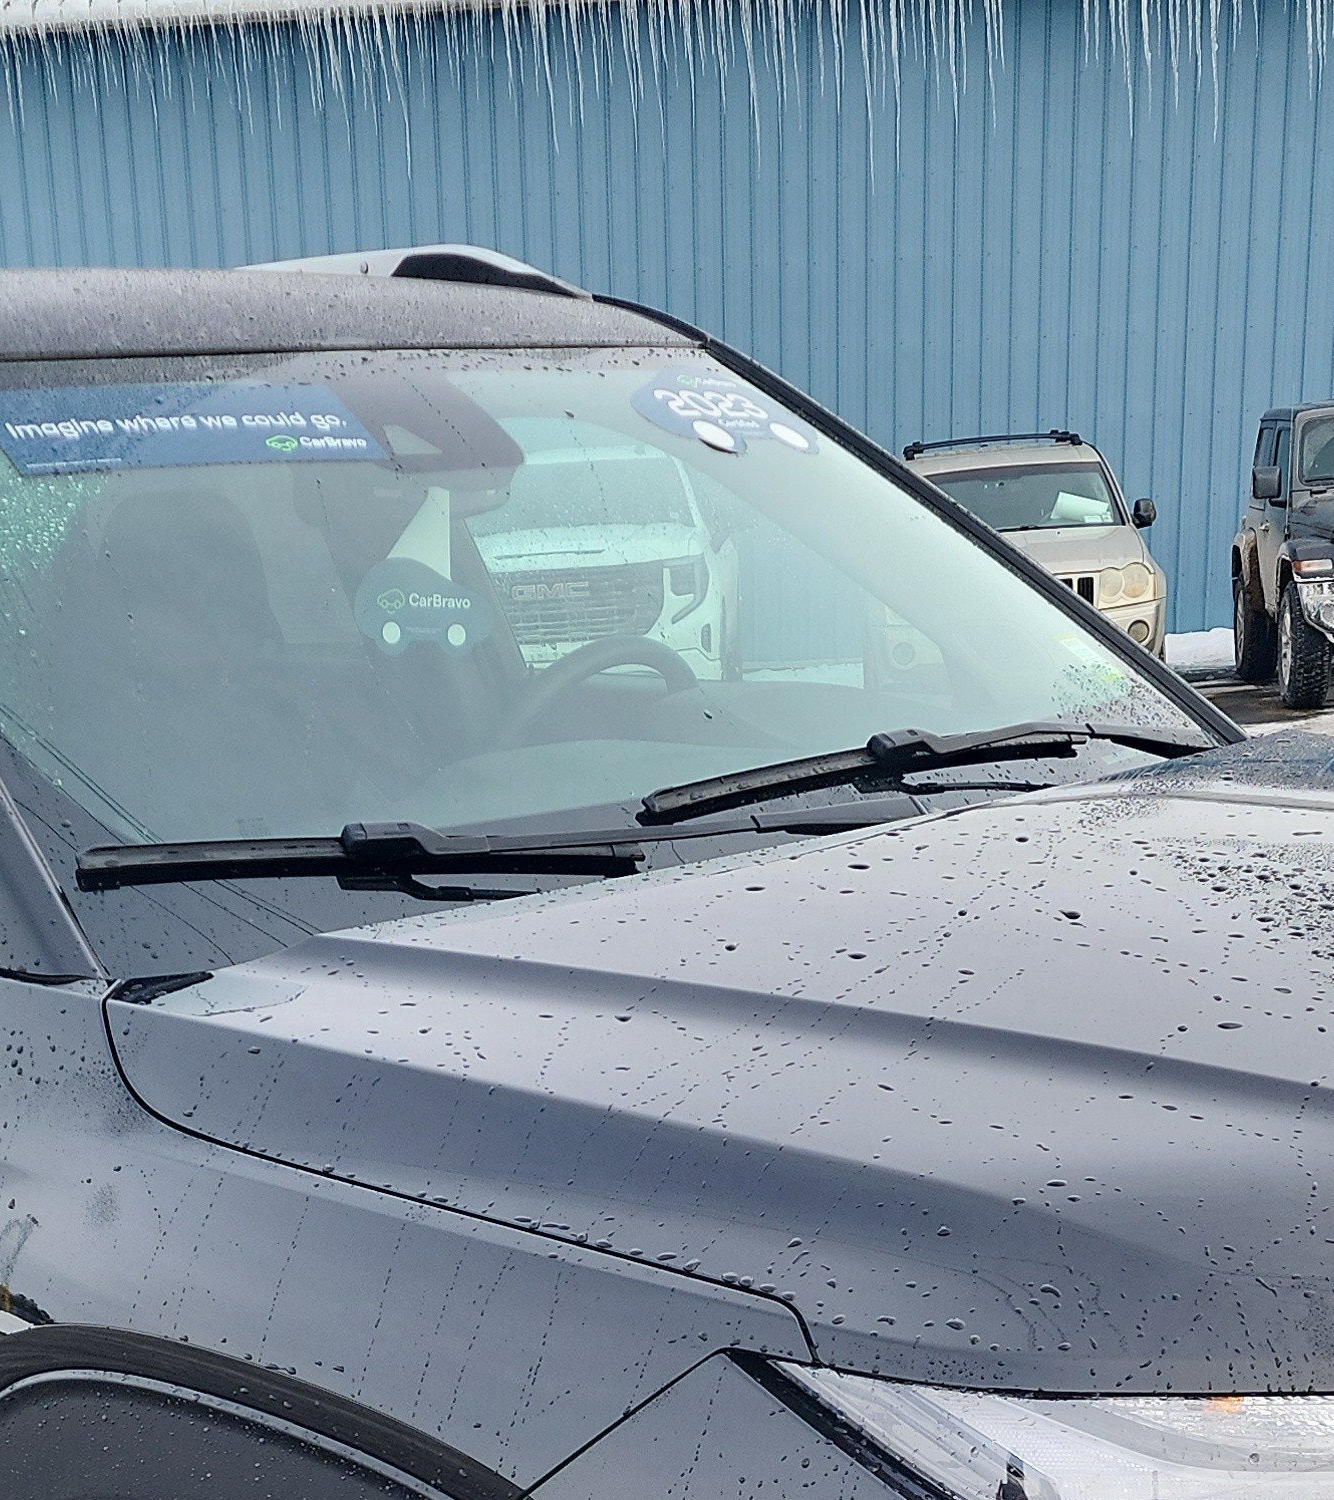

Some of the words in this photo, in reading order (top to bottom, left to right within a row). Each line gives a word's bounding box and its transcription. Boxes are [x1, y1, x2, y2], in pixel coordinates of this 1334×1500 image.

[653, 388, 769, 419] 2023
[5, 418, 114, 440] Imagine
[115, 414, 198, 433] where
[198, 414, 238, 430] we
[241, 411, 307, 428] could
[310, 413, 347, 431] go.
[299, 435, 368, 449] CarBravo
[510, 580, 589, 600] GMC
[408, 592, 471, 609] CarBravo
